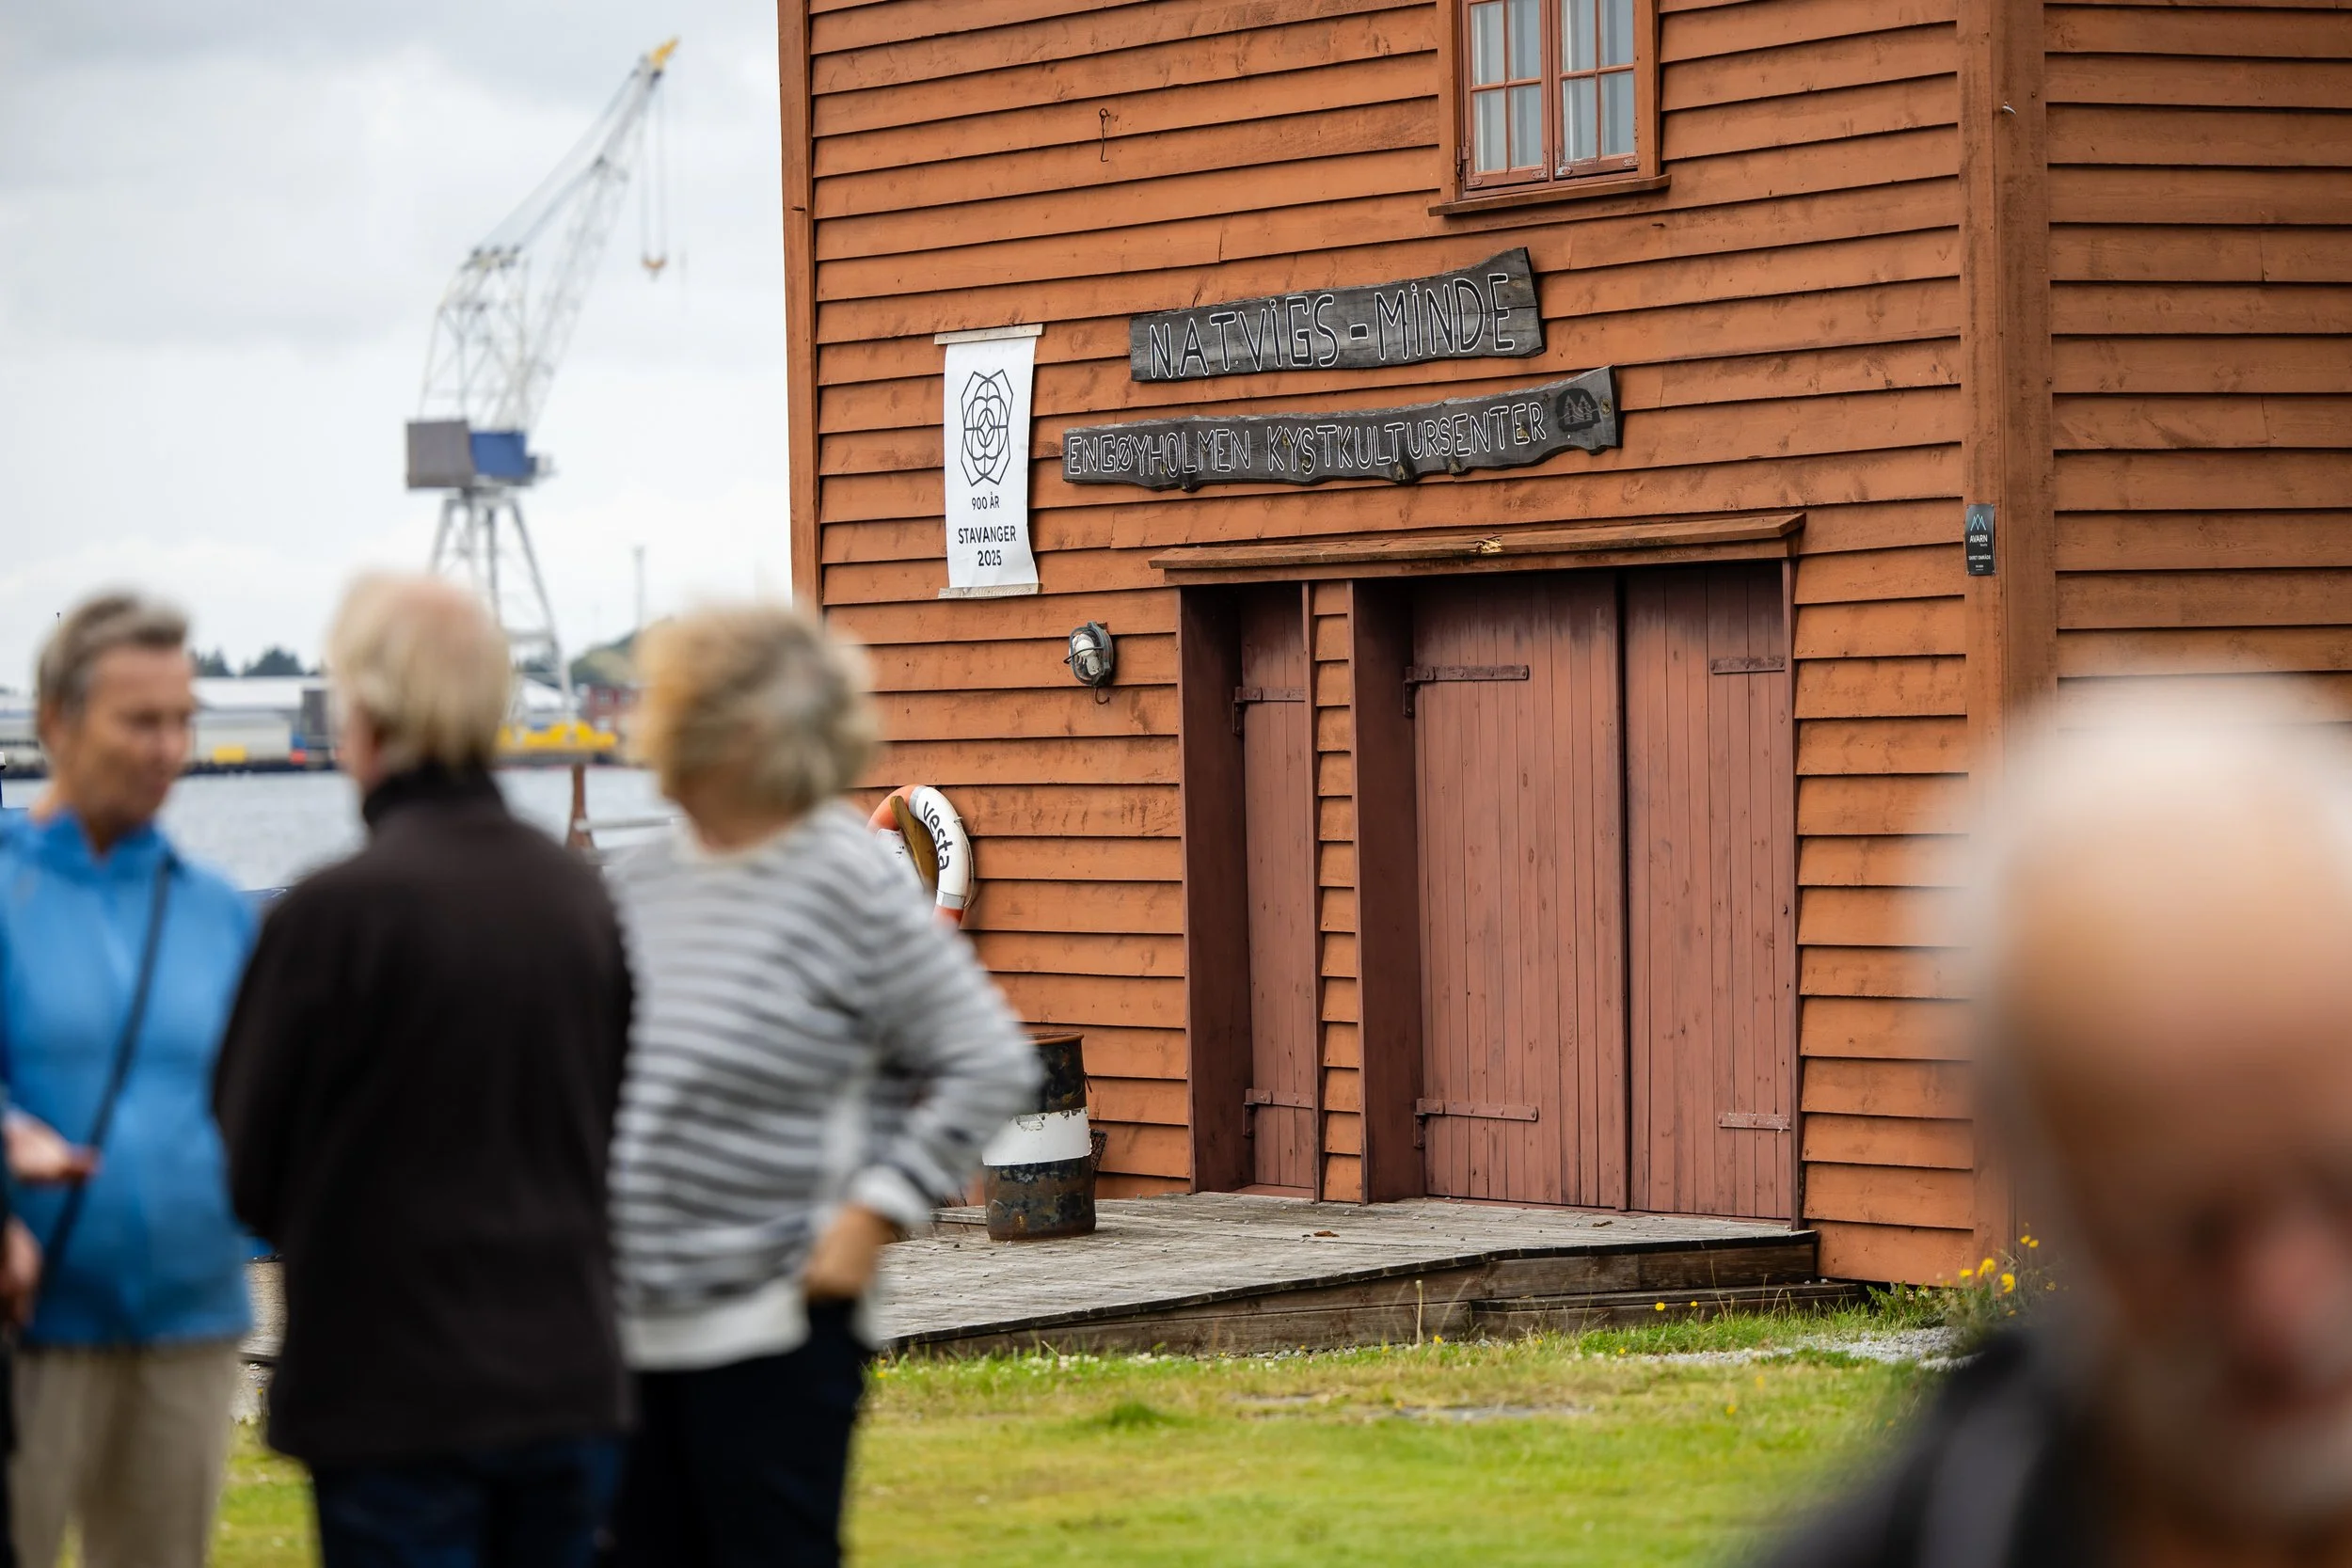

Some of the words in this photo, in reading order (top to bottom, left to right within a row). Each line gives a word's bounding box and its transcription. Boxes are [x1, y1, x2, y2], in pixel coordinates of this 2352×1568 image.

[1068, 428, 1251, 478] ENGØYHOLMEN
[1266, 402, 1547, 475] KYSTKULTURSENTER
[971, 496, 988, 510] 900
[990, 491, 1000, 509] ÅR
[958, 525, 1017, 545] STAVANGER
[1969, 534, 1988, 543] AVARN
[977, 549, 1002, 566] 2025
